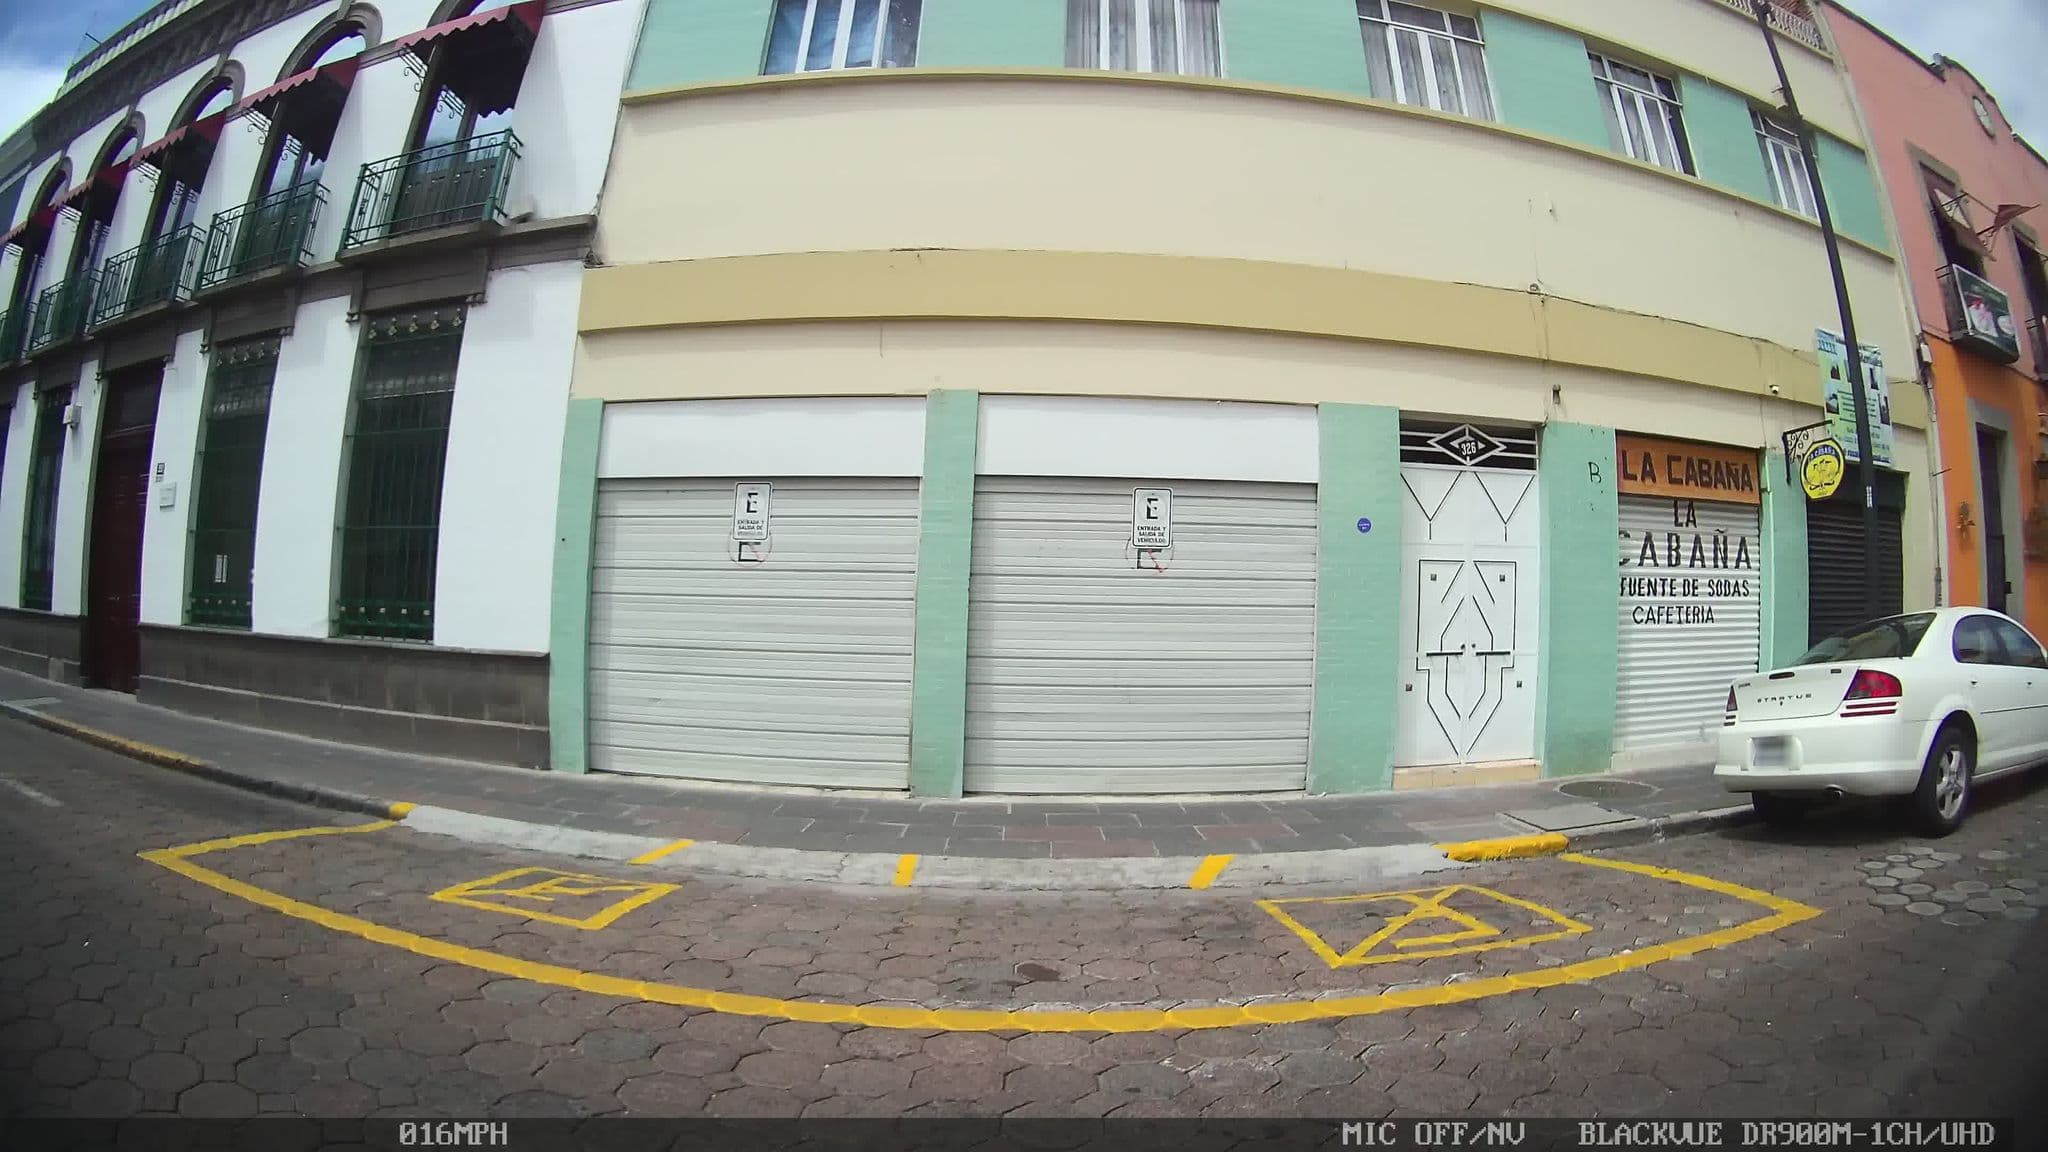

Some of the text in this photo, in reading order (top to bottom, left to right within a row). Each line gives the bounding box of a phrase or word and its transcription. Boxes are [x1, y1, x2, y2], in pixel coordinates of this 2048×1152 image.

[1461, 442, 1476, 455] 326
[1622, 450, 1753, 492] LA CABAÑA
[1673, 500, 1697, 528] LA
[1620, 577, 1750, 597] FUENTE DE SODAS
[1632, 605, 1715, 625] CAFETERIA
